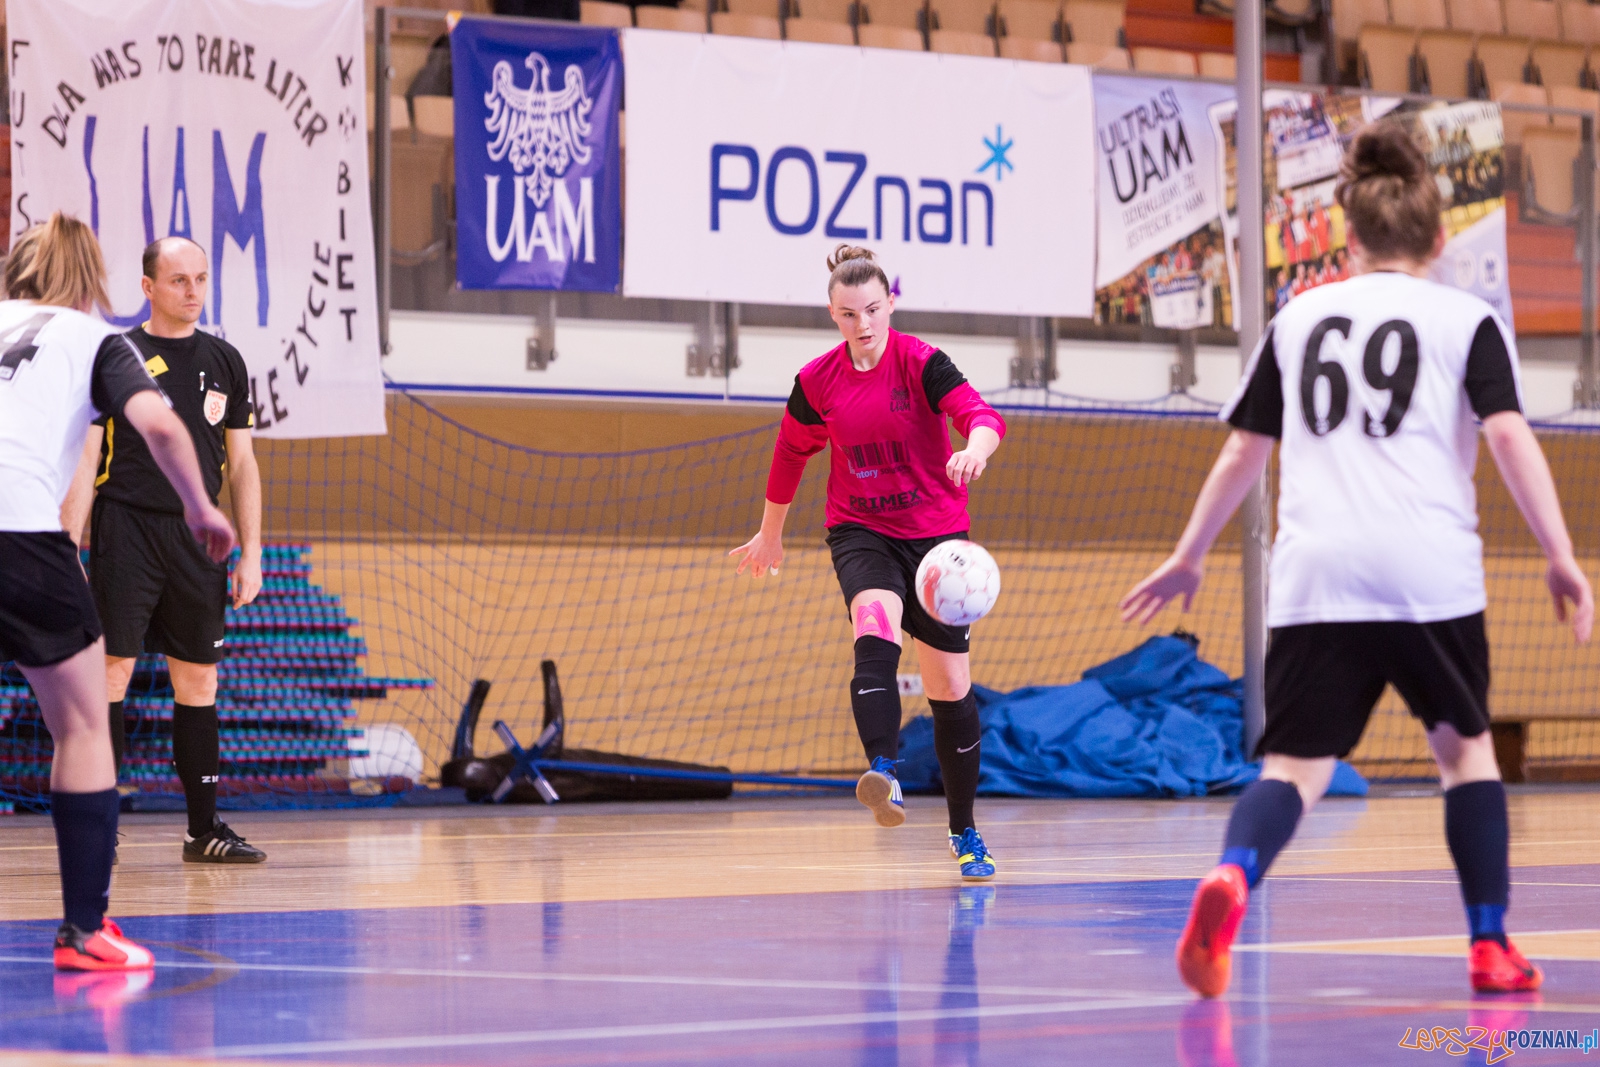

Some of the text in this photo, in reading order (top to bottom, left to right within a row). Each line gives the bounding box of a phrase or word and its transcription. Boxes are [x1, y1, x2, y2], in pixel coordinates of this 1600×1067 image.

[42, 80, 86, 148] DLA
[1109, 119, 1194, 203] UAM
[83, 115, 270, 327] UAM
[484, 173, 596, 264] UAM
[250, 241, 331, 431] ŁE ŻYCIE
[1300, 316, 1420, 438] 69
[849, 487, 922, 509] PRIMEX
